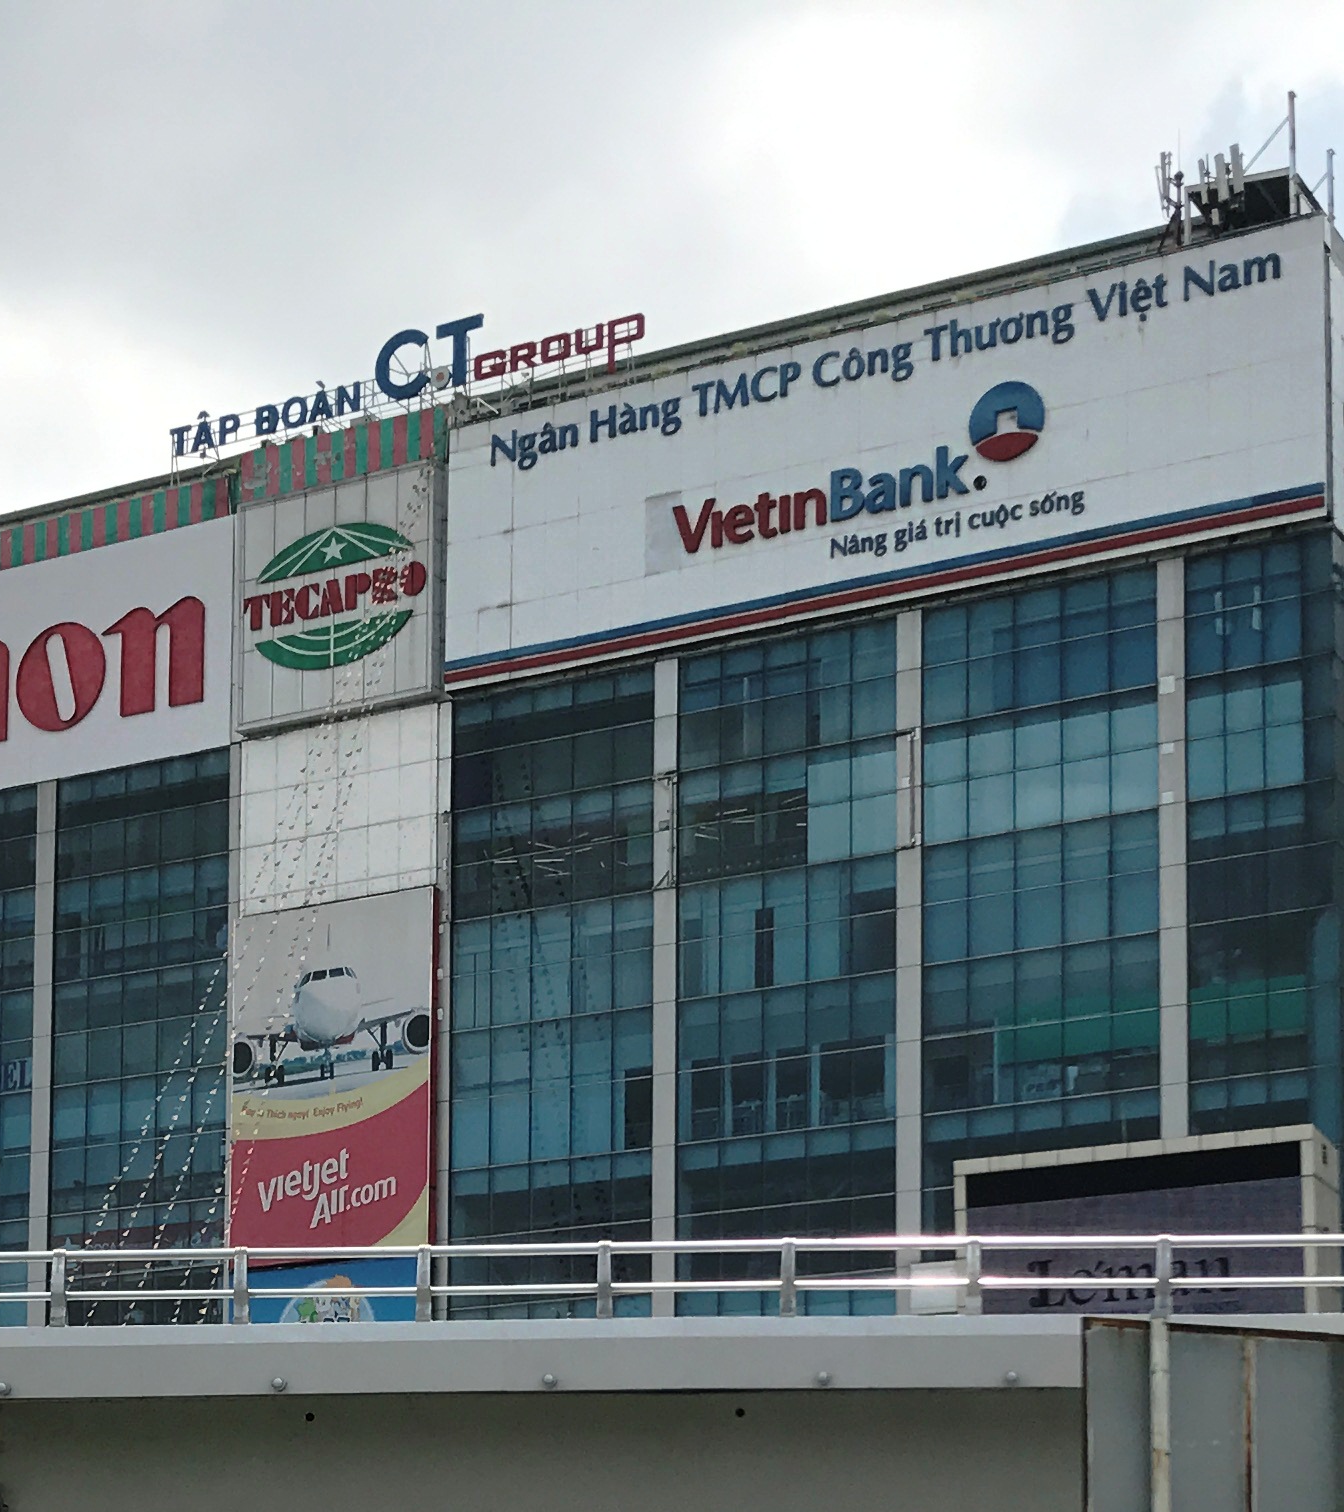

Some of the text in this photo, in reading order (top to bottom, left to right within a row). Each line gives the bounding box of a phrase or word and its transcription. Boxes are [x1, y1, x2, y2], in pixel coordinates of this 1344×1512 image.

[255, 379, 362, 435] ĐOÀN
[375, 313, 485, 400] CT
[473, 313, 646, 382] GROUP
[489, 252, 1283, 469] Ngân Hàng TMCP Công Thương Việt Nam
[672, 446, 972, 555] VietinBank
[829, 488, 1086, 559] Nâng giá trị cuộc sống
[244, 561, 426, 631] TECAPRO
